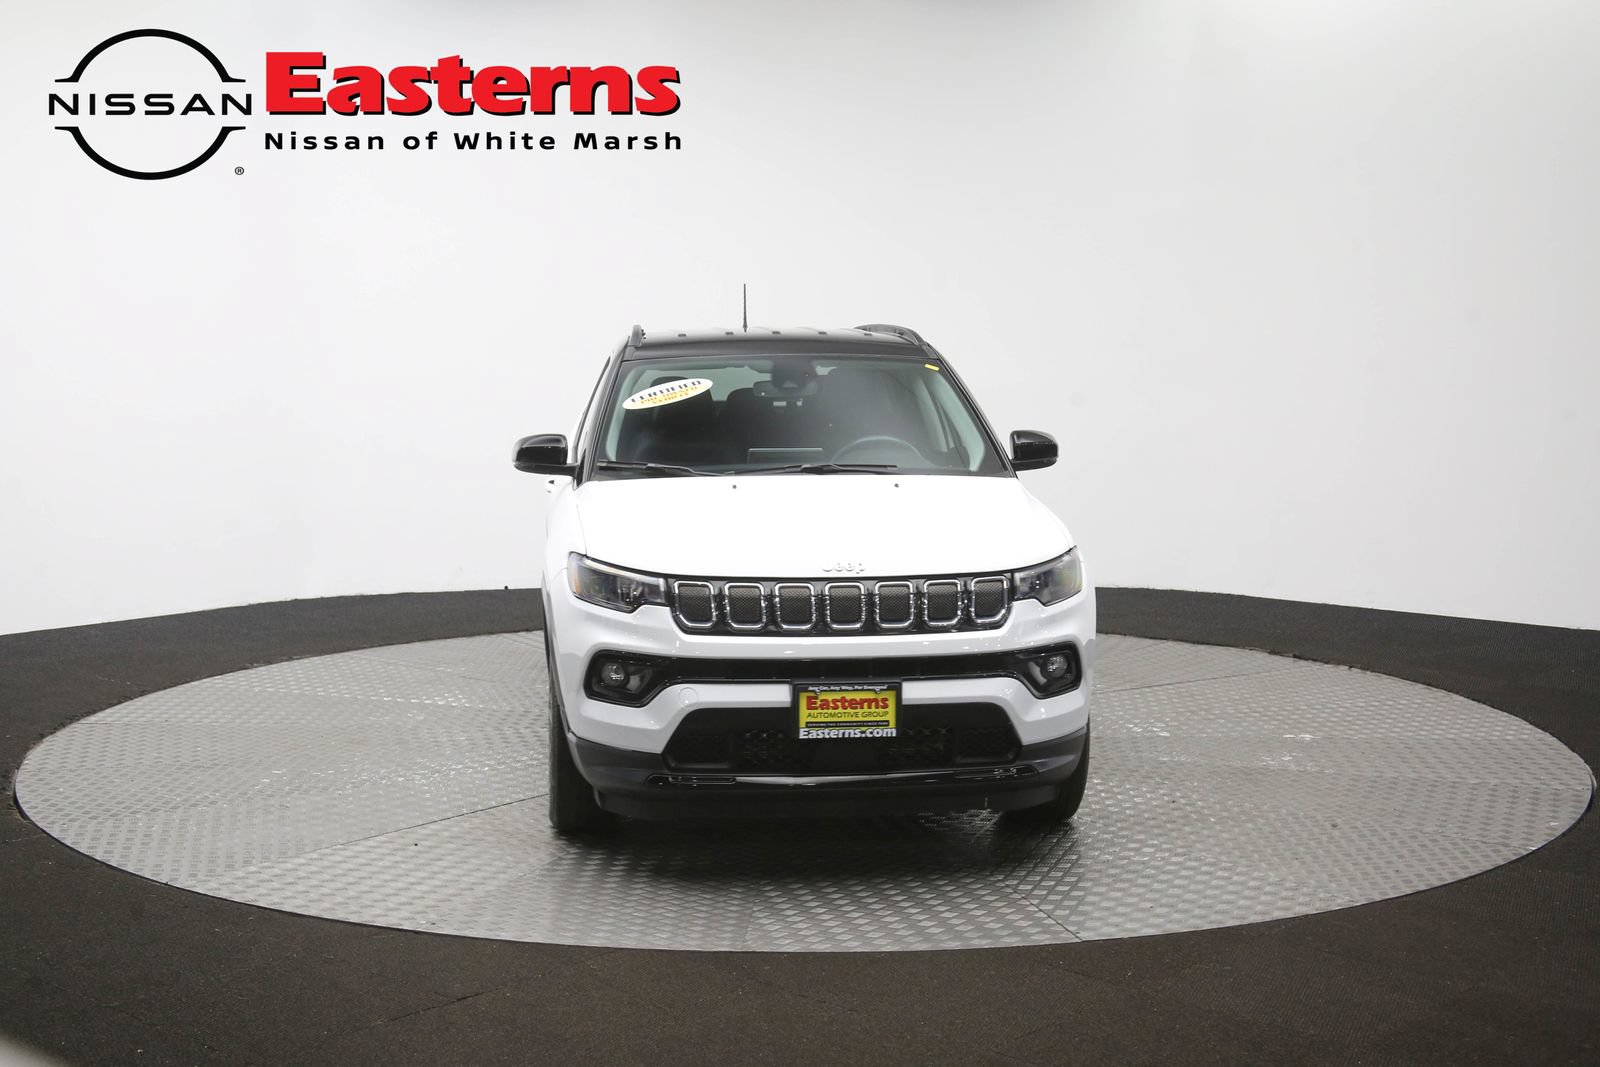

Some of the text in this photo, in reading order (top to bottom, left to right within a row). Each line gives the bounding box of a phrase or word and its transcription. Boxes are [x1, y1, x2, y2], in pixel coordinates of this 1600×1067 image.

[806, 695, 889, 710] Easterns
[807, 711, 860, 719] AUTOMOTIVE
[799, 728, 897, 739] Easterns.com
